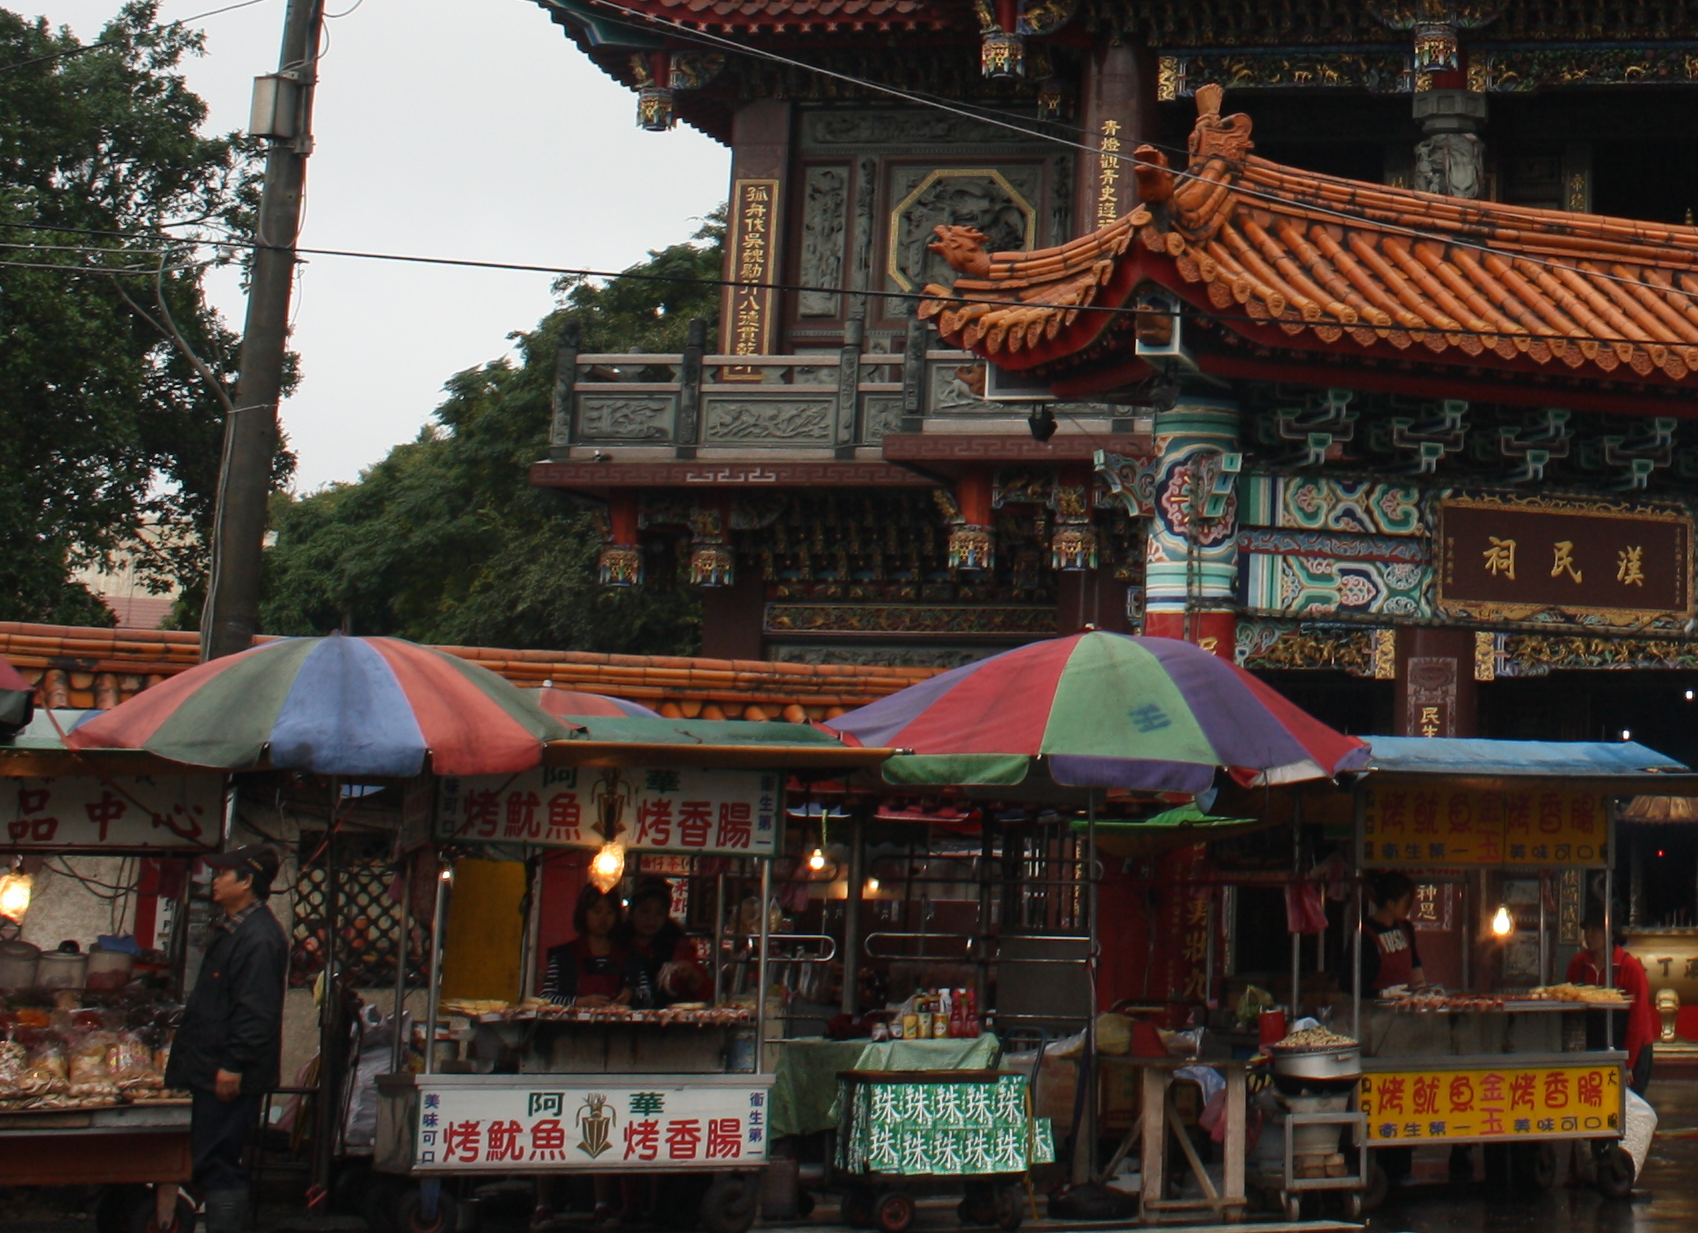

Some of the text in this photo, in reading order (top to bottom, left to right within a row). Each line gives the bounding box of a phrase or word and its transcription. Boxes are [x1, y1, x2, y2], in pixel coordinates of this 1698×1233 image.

[637, 798, 753, 849] 烤香腸
[1510, 1070, 1603, 1112] 烤香腸
[442, 1118, 744, 1164] 烤魷魚 烤香腸
